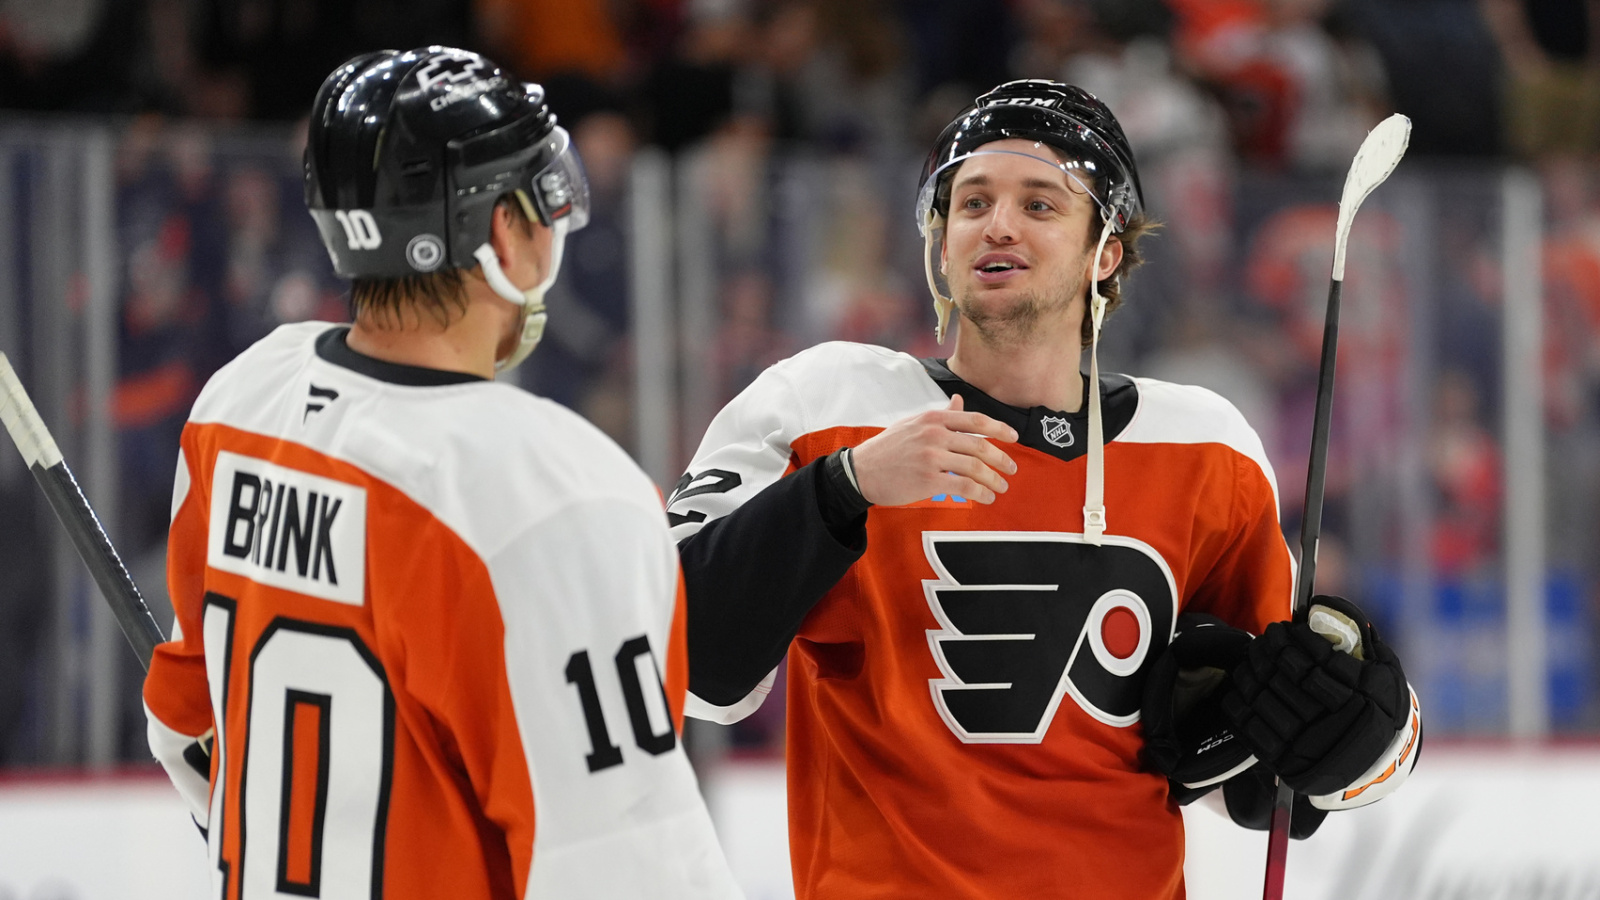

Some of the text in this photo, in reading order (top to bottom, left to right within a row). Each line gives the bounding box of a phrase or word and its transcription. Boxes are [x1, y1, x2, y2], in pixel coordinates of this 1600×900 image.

[335, 209, 381, 250] 10
[223, 471, 342, 586] BRINK
[565, 635, 678, 774] 10
[1197, 734, 1234, 755] CCM
